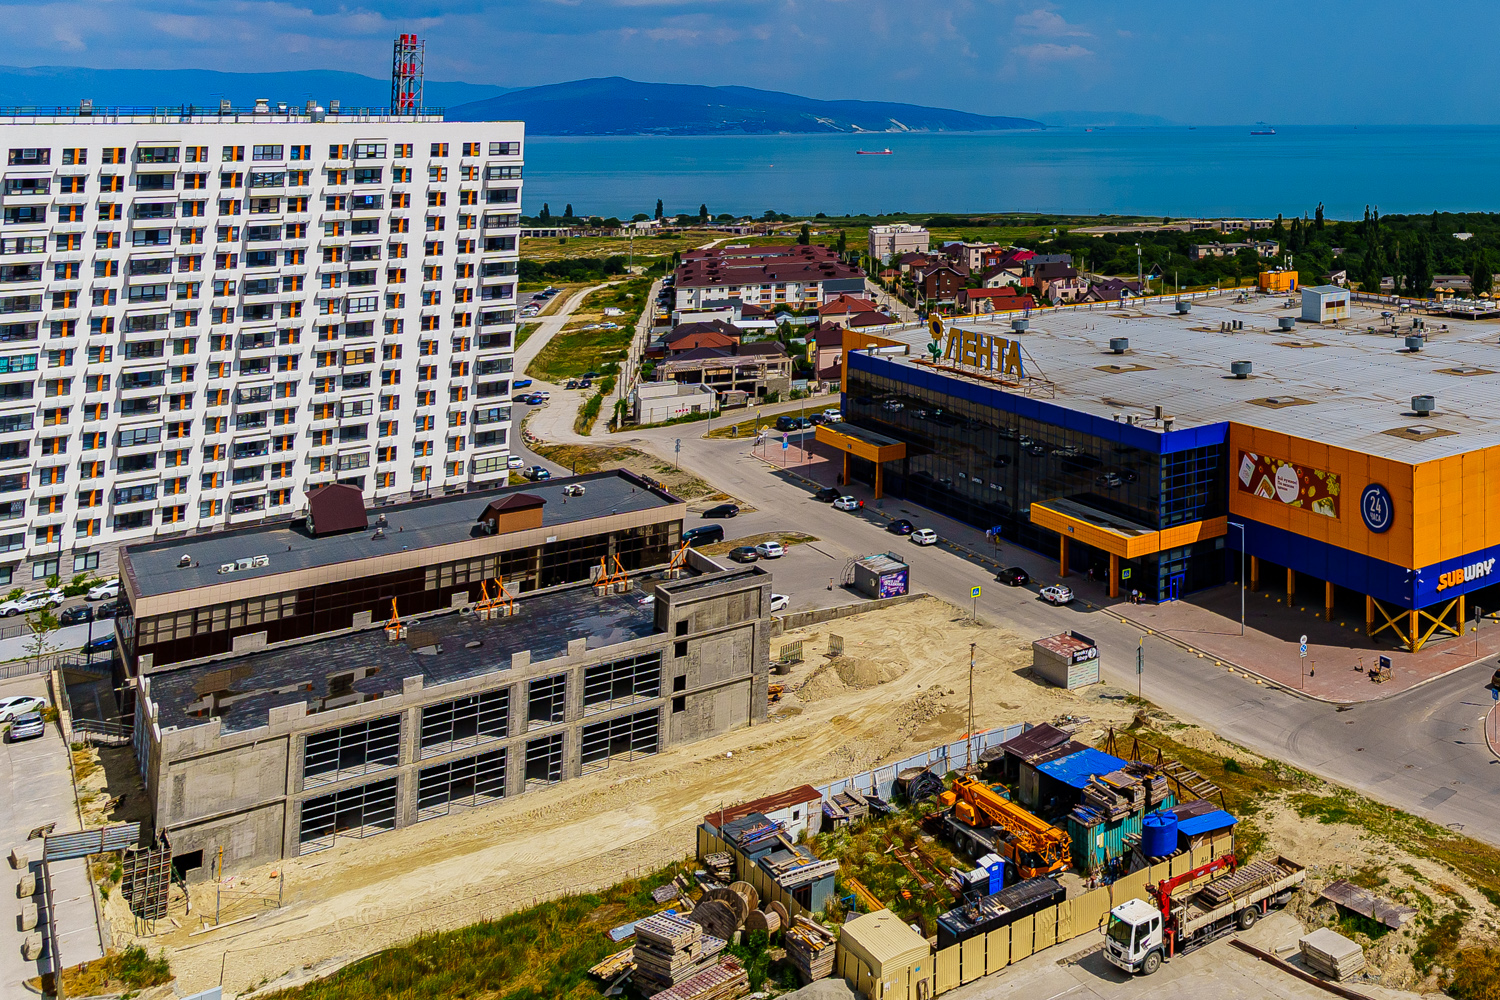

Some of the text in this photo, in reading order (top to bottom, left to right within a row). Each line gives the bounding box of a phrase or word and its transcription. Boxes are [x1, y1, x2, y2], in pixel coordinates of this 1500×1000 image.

[944, 327, 1024, 379] ЛЕНТА
[1370, 496, 1381, 513] 24
[1436, 557, 1495, 591] SUBWAY
